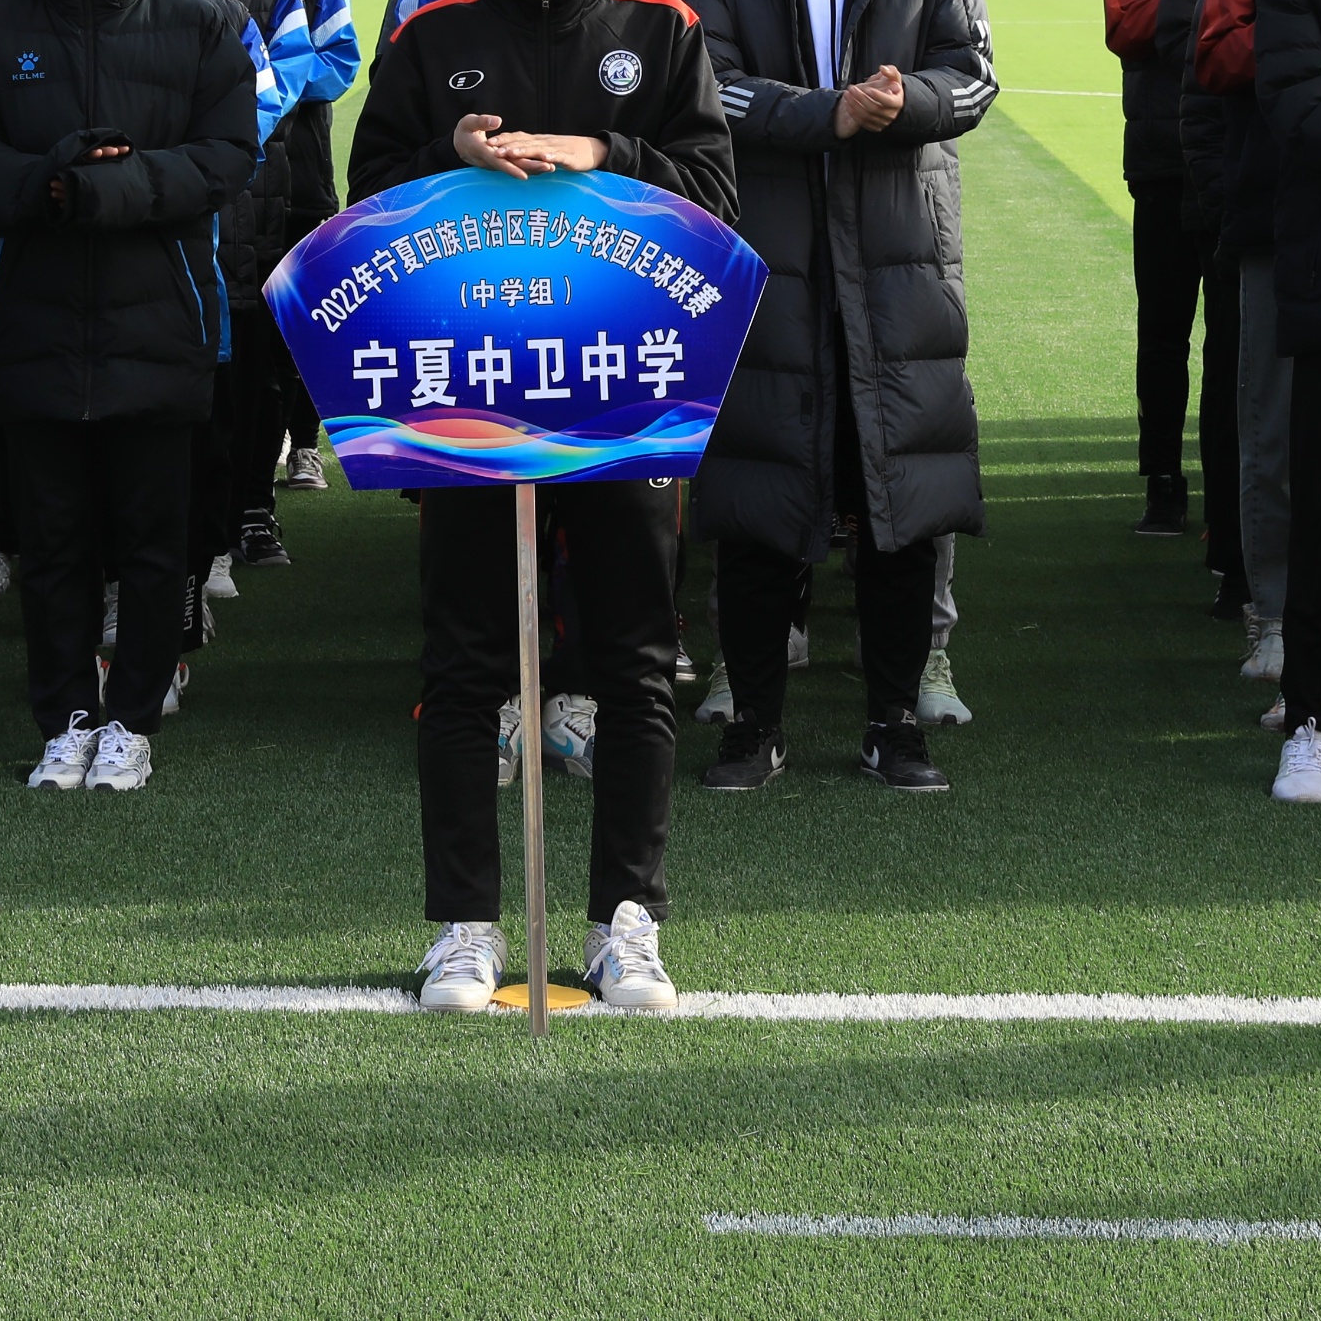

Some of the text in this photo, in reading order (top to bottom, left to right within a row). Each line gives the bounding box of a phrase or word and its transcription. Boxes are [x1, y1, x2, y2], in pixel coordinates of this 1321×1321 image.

[12, 72, 46, 81] KELME
[310, 208, 722, 333] 2022年宁夏回族自治区青少年校园足球联赛
[351, 327, 686, 411] 宁夏中卫中学
